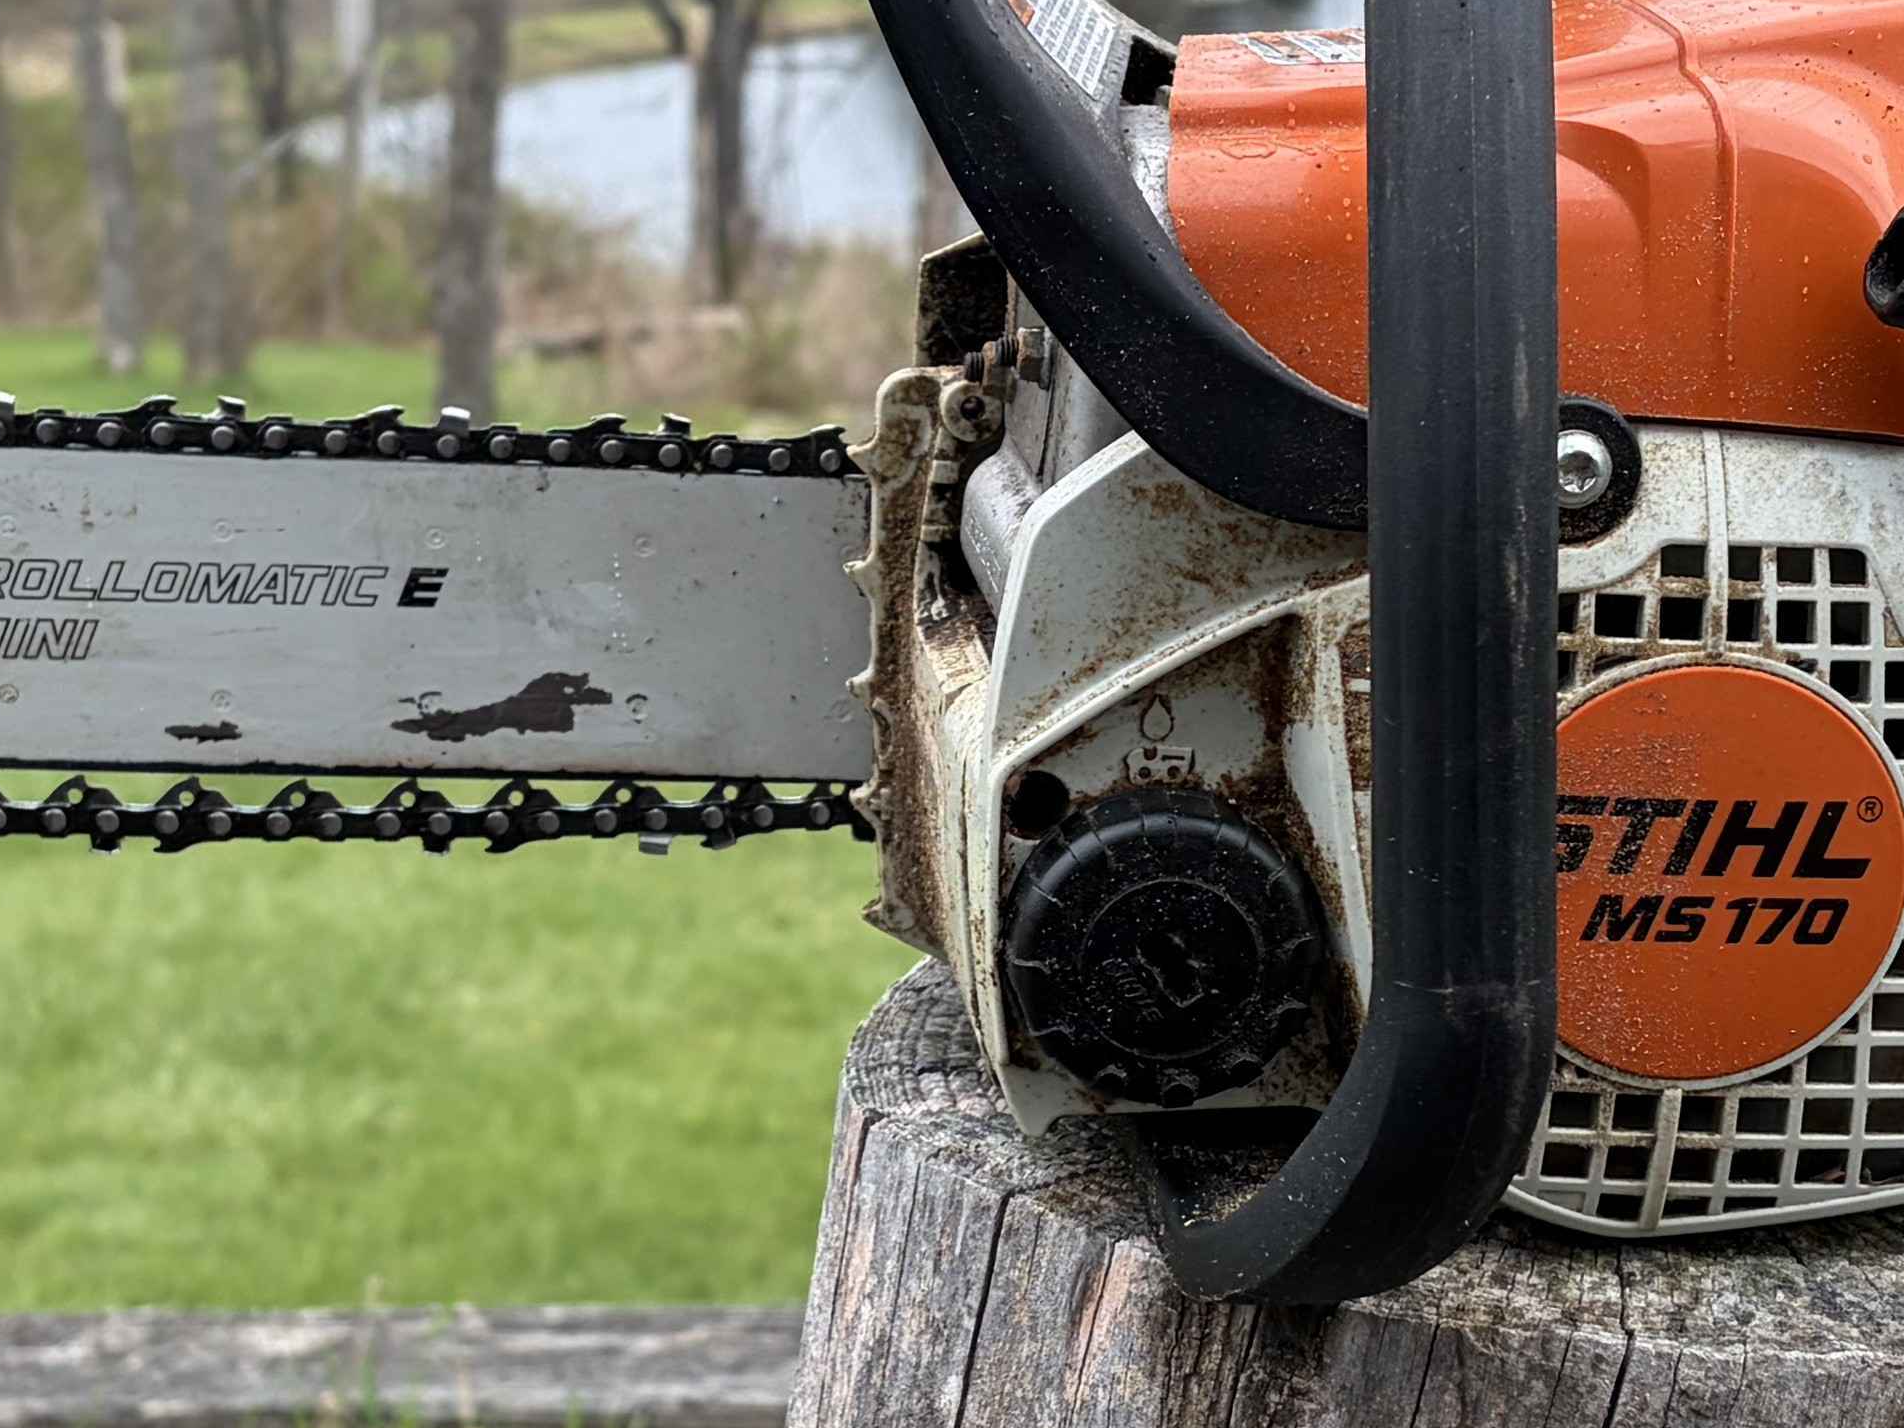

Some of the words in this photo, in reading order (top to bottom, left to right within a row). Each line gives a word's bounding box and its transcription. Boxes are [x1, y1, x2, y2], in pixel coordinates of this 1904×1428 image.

[397, 568, 449, 608] E
[1579, 894, 1713, 943] MS
[1724, 895, 1849, 946] 170
